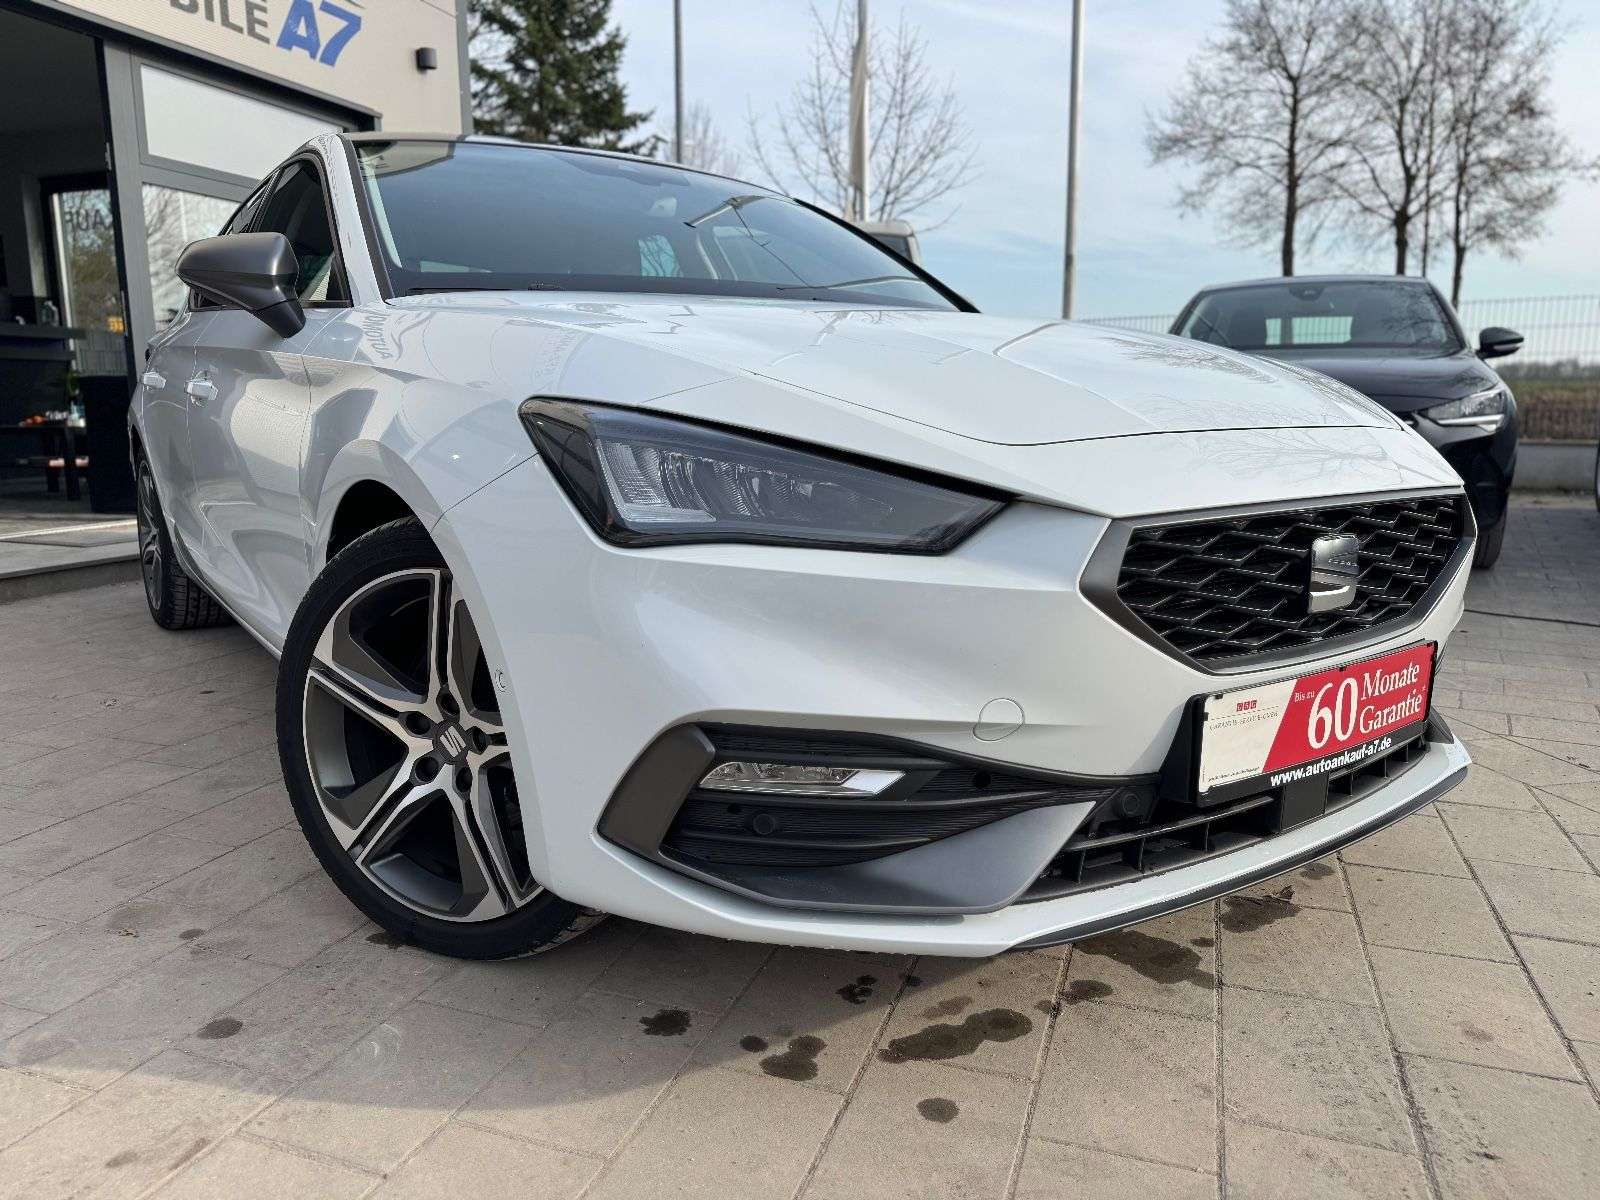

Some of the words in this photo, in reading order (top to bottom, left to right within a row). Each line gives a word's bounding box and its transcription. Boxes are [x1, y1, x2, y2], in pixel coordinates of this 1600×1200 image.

[276, 0, 362, 67] A7
[1295, 692, 1306, 702] Bis
[1307, 691, 1315, 699] zu
[1361, 662, 1420, 700] Monate
[1308, 677, 1359, 749] 60
[1360, 689, 1422, 734] Garantie
[1270, 736, 1392, 787] www.autoankauf-a7.de
